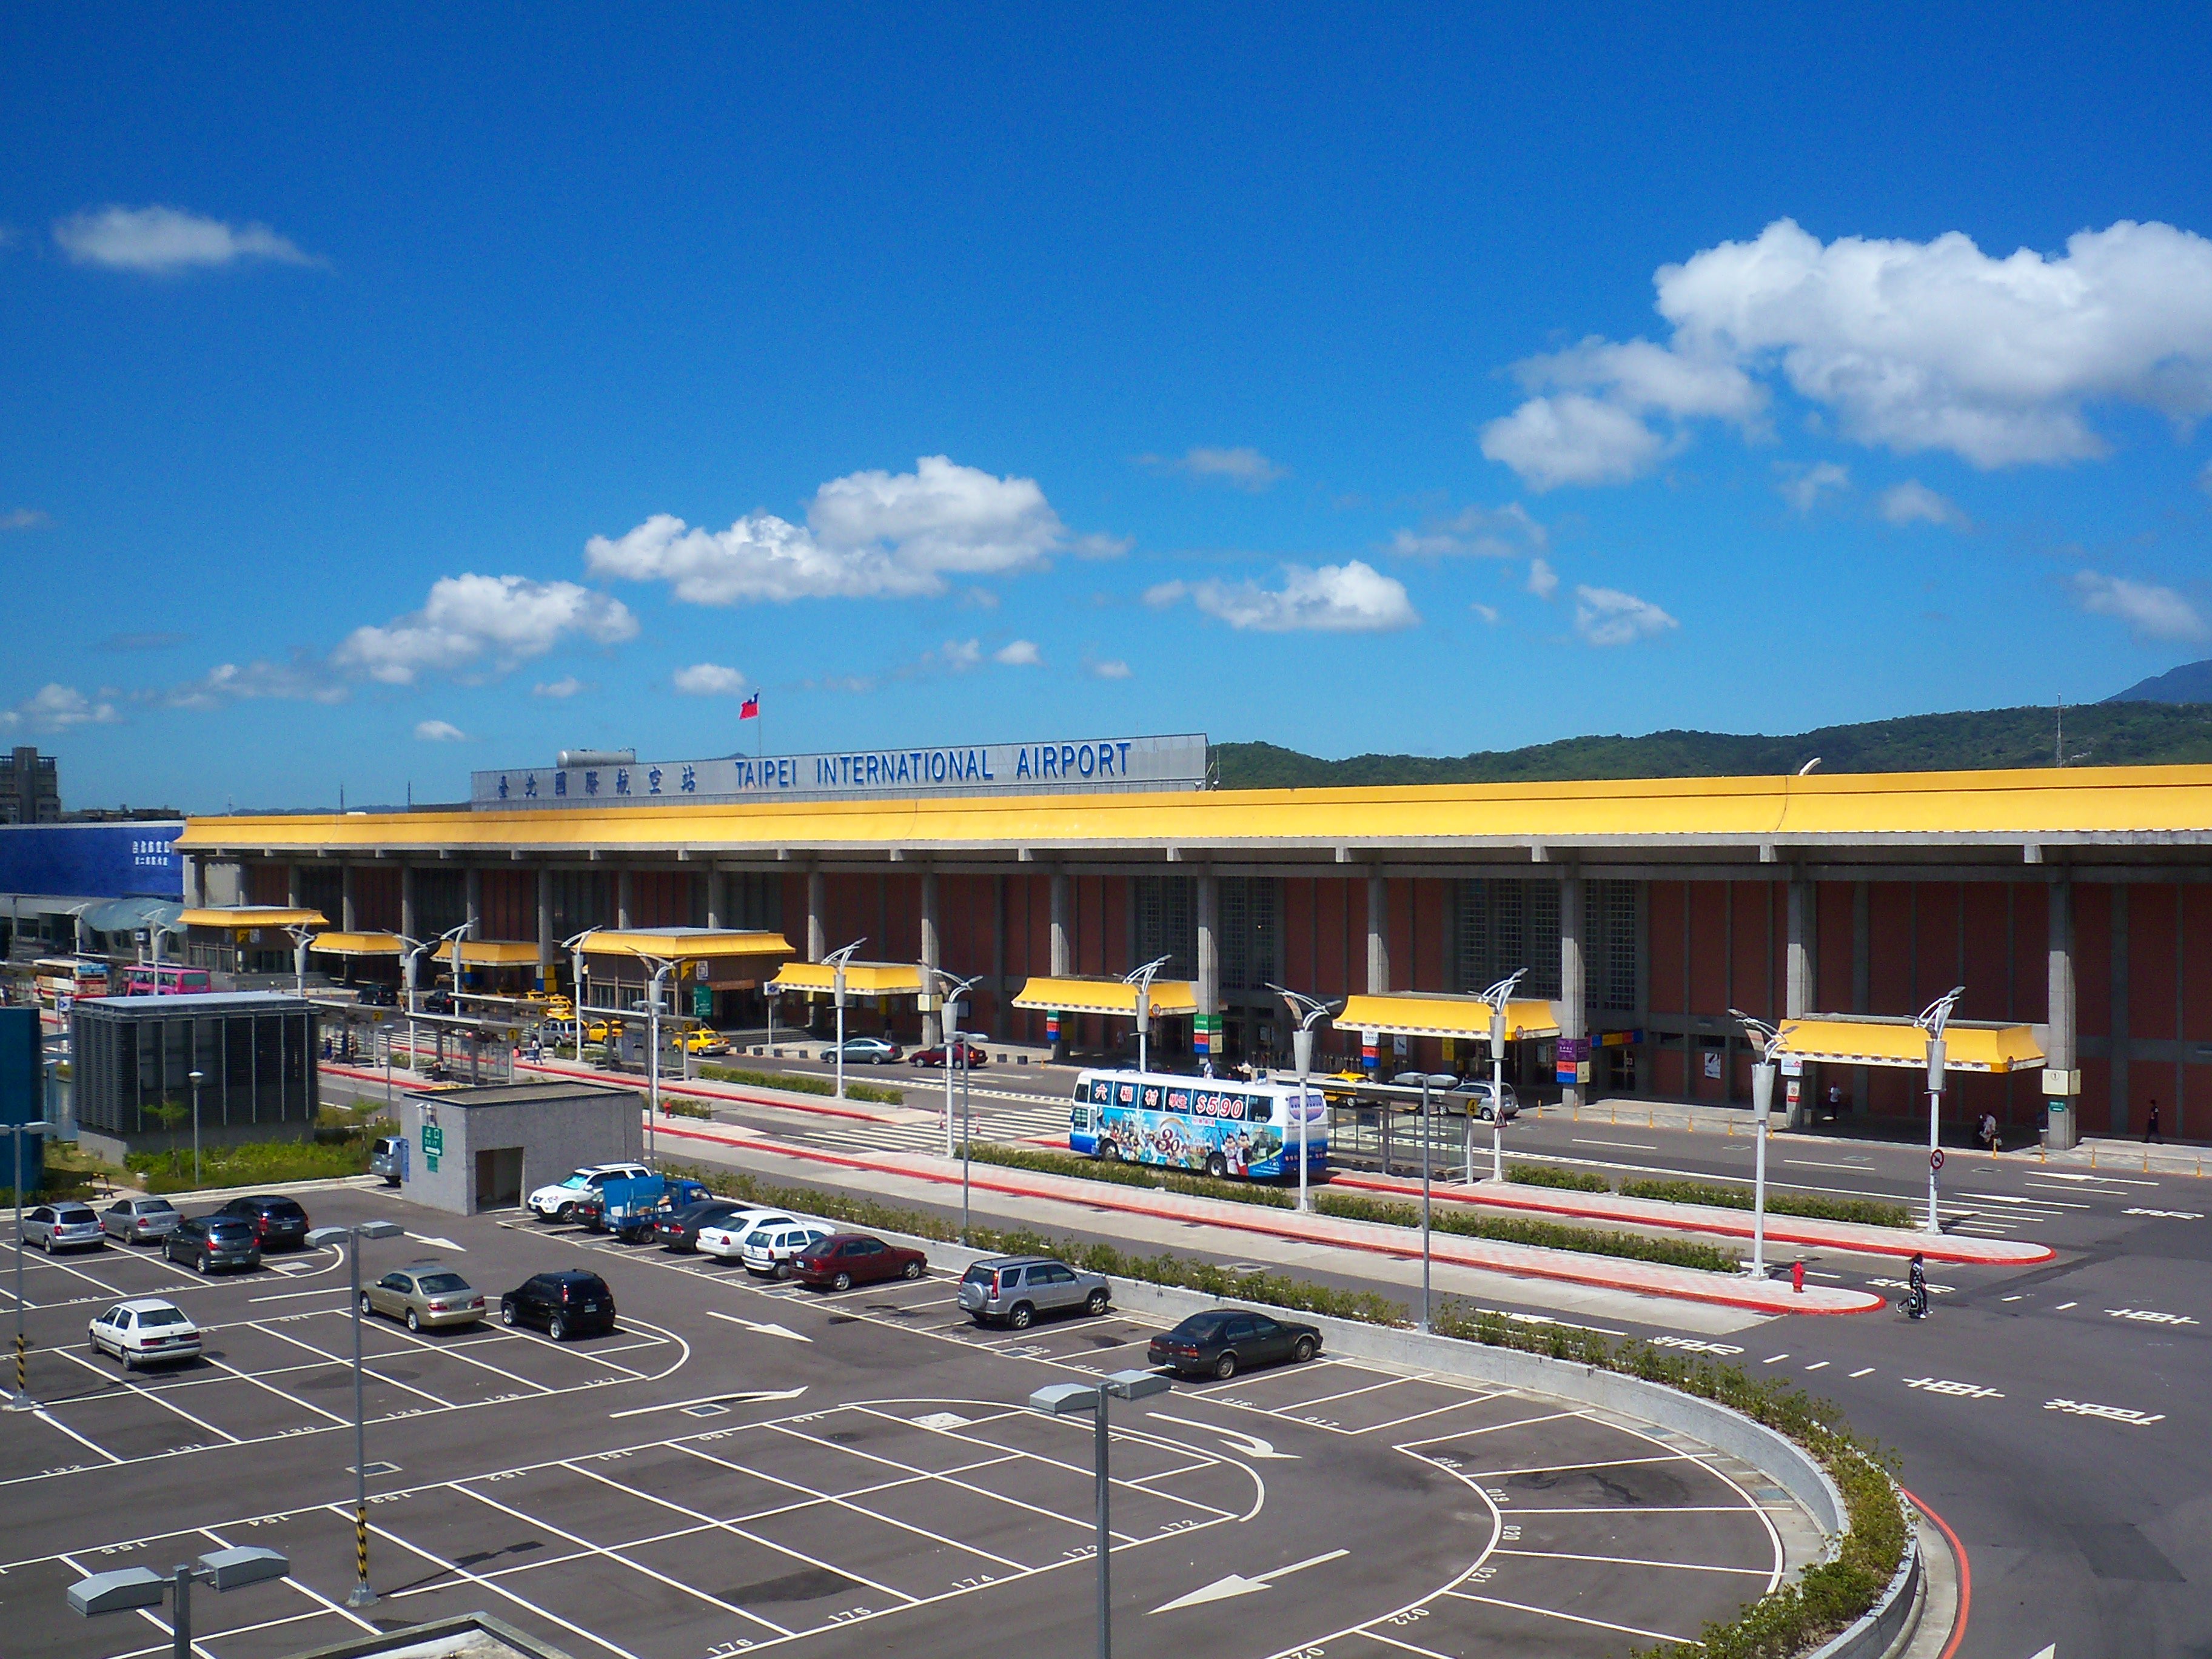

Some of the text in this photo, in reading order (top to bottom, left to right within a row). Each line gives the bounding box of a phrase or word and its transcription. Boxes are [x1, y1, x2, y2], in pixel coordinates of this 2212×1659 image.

[735, 742, 1131, 788] TAIPEI INTERNATIONAL AIRPORT
[510, 1031, 515, 1039] 1
[1195, 1093, 1244, 1119] $590
[1469, 1101, 1476, 1113] 4
[1156, 1128, 1180, 1151] 30
[1304, 1416, 1341, 1427] 017
[1486, 1488, 1510, 1502] 019
[1159, 1520, 1199, 1532] 172
[1502, 1524, 1521, 1541] 020
[951, 1574, 994, 1591] 174
[1467, 1567, 1498, 1583] 021
[827, 1607, 873, 1623] 175
[1388, 1608, 1430, 1626] 022
[706, 1638, 754, 1657] 176
